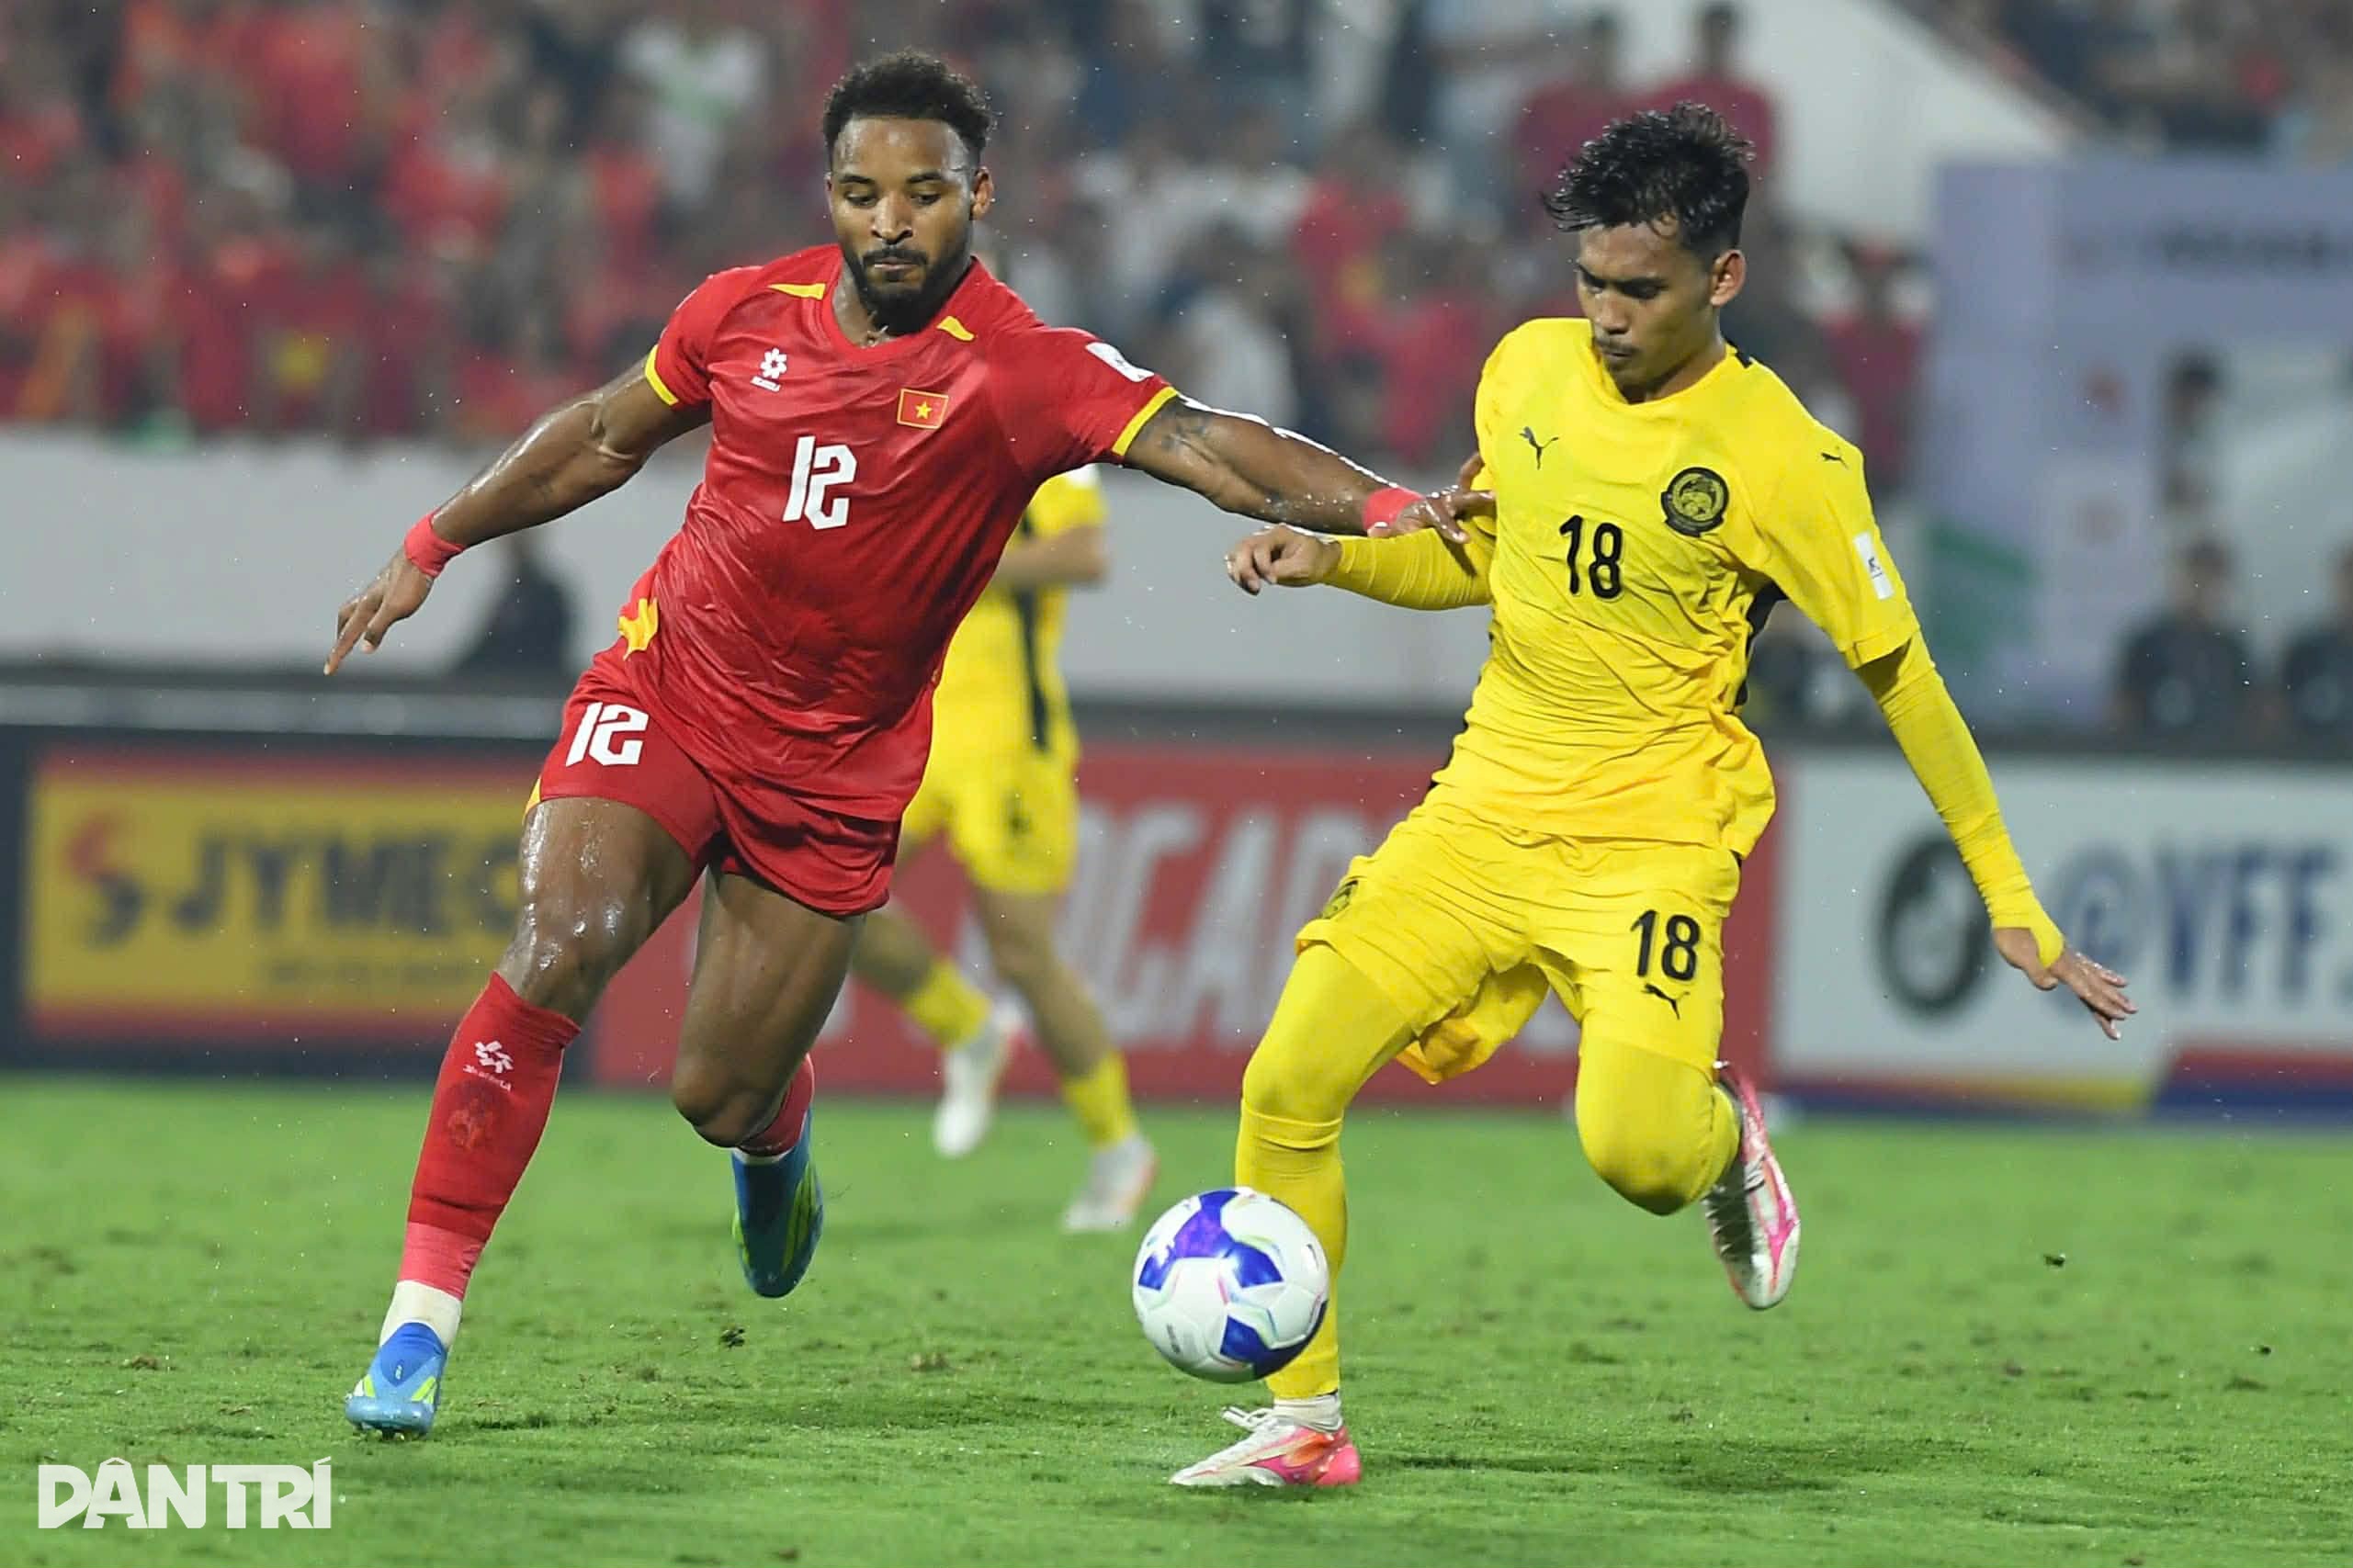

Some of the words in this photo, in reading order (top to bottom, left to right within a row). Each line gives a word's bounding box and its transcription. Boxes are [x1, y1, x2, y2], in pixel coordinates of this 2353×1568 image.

[783, 435, 857, 529] 12
[1559, 514, 1623, 599] 18
[566, 702, 650, 766] 12
[1631, 909, 1701, 981] 18
